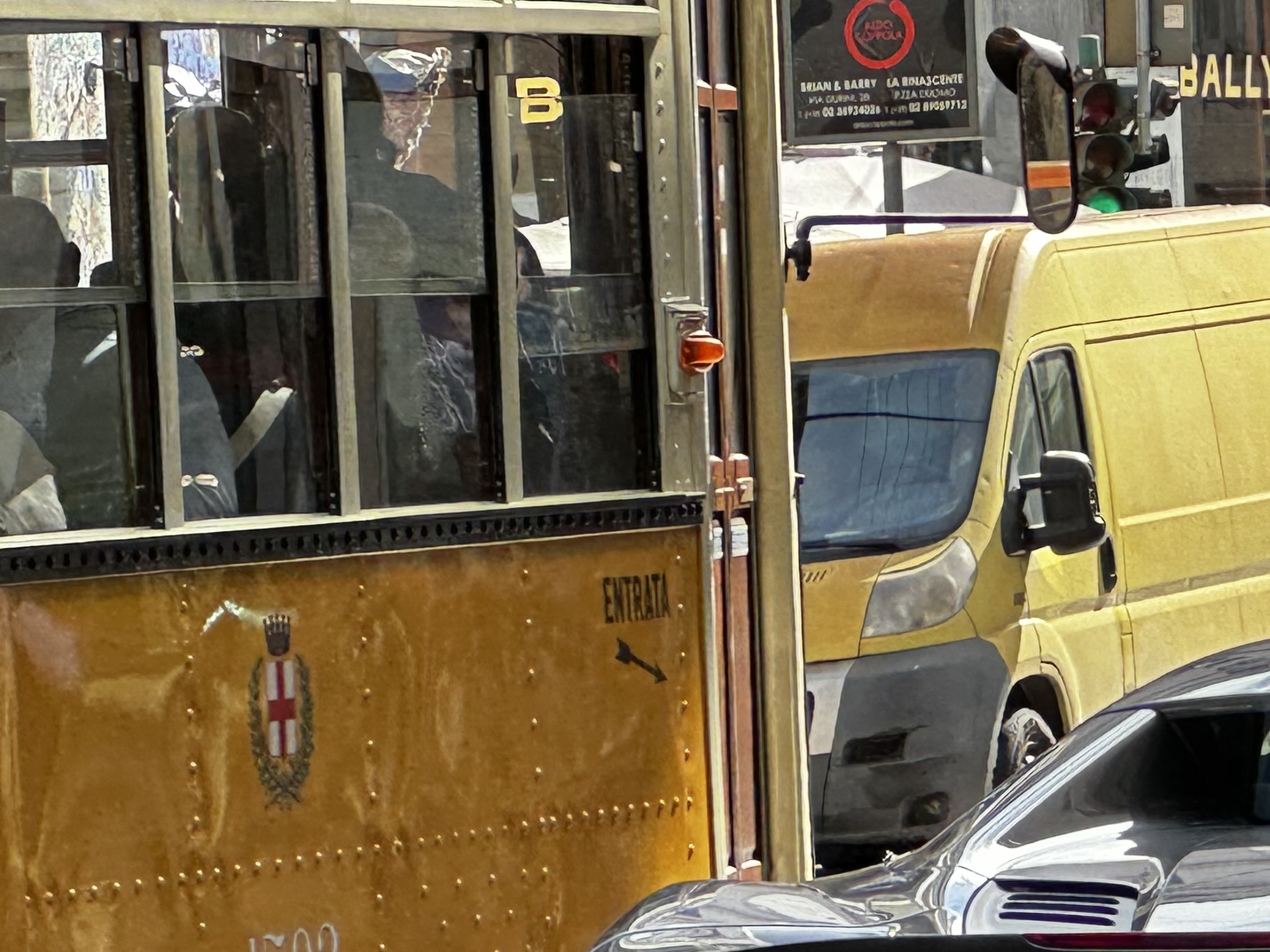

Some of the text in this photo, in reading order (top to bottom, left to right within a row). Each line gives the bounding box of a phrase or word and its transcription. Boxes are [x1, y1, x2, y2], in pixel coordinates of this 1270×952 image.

[515, 76, 564, 124] B
[886, 77, 900, 88] LA
[602, 572, 671, 624] ENTRATA
